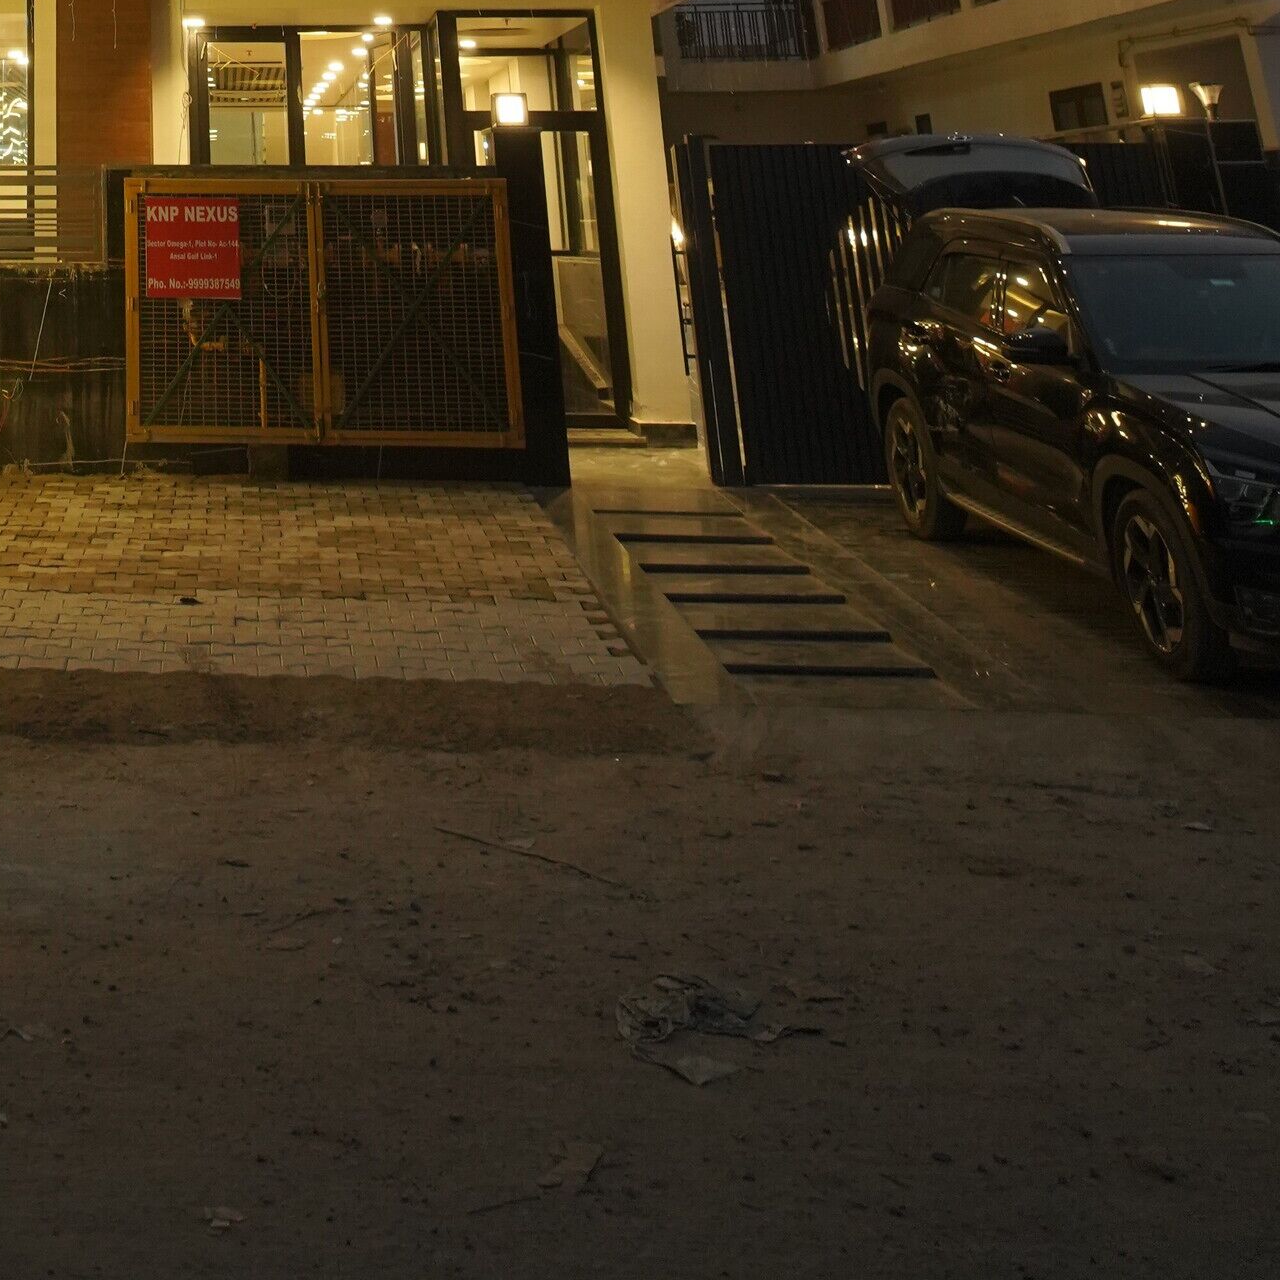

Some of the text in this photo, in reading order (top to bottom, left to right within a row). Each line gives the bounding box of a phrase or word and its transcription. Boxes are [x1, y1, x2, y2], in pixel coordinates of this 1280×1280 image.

[146, 206, 238, 222] KNP NEXUS
[148, 278, 167, 289] Pho.
